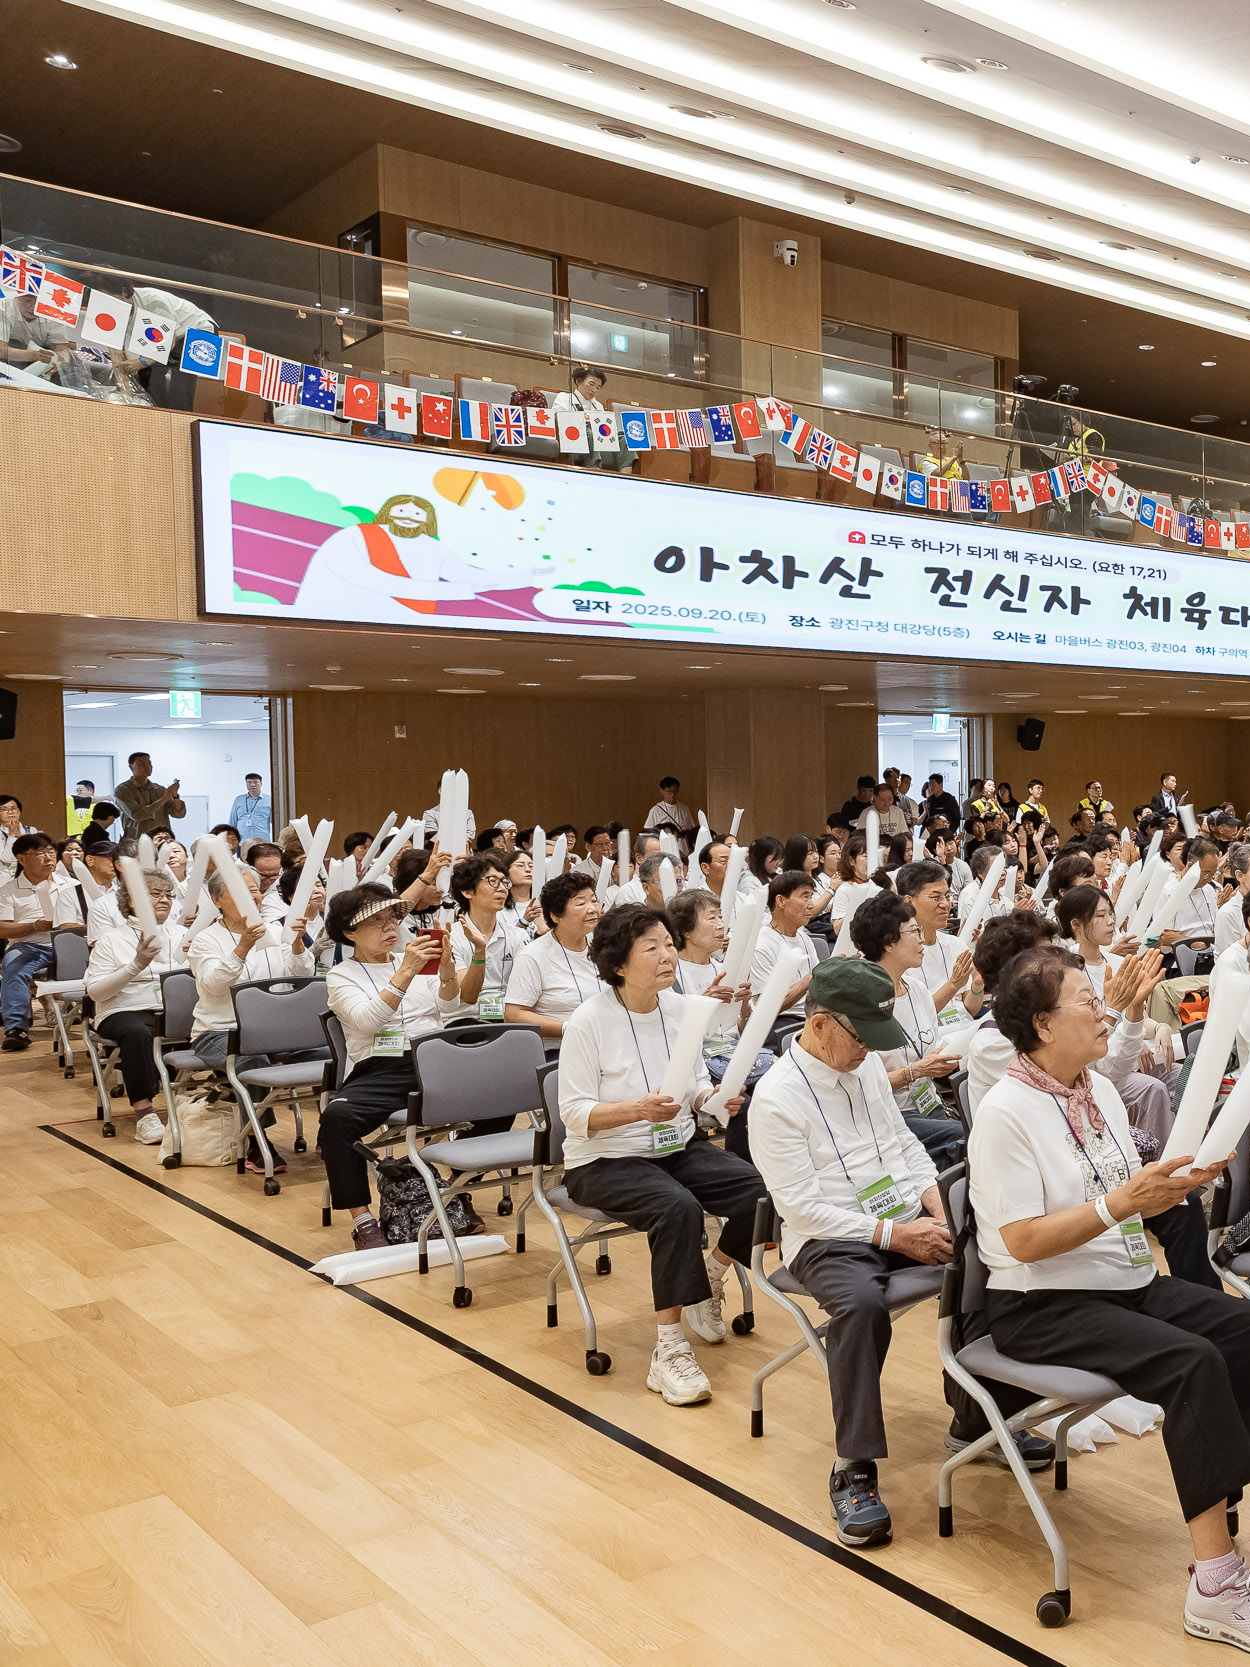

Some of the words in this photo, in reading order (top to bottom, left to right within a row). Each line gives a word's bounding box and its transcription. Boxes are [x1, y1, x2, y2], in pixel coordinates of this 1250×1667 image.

[869, 533, 906, 550] 모두
[911, 537, 962, 556] 하나가
[967, 544, 998, 562] 되게
[1003, 549, 1019, 564] 해
[1023, 552, 1087, 571] 주십시오.
[1092, 560, 1125, 576] (요한
[1129, 565, 1168, 581] 17,21)
[652, 545, 885, 600] 아차산
[923, 566, 1092, 616] 전신자
[572, 598, 612, 614] 일자
[621, 603, 767, 625] 2025.09.20.(토)
[788, 615, 822, 629] 장소
[829, 617, 890, 633] 광진구청
[893, 622, 970, 640] 대강당(5층)
[992, 630, 1032, 644] 오시는
[1034, 633, 1047, 645] 길
[1055, 634, 1103, 648] 마을버스
[1105, 637, 1148, 653] 광진03,
[1149, 642, 1187, 654] 광진04
[1194, 645, 1216, 657] 하차
[1217, 647, 1248, 659] 구의역
